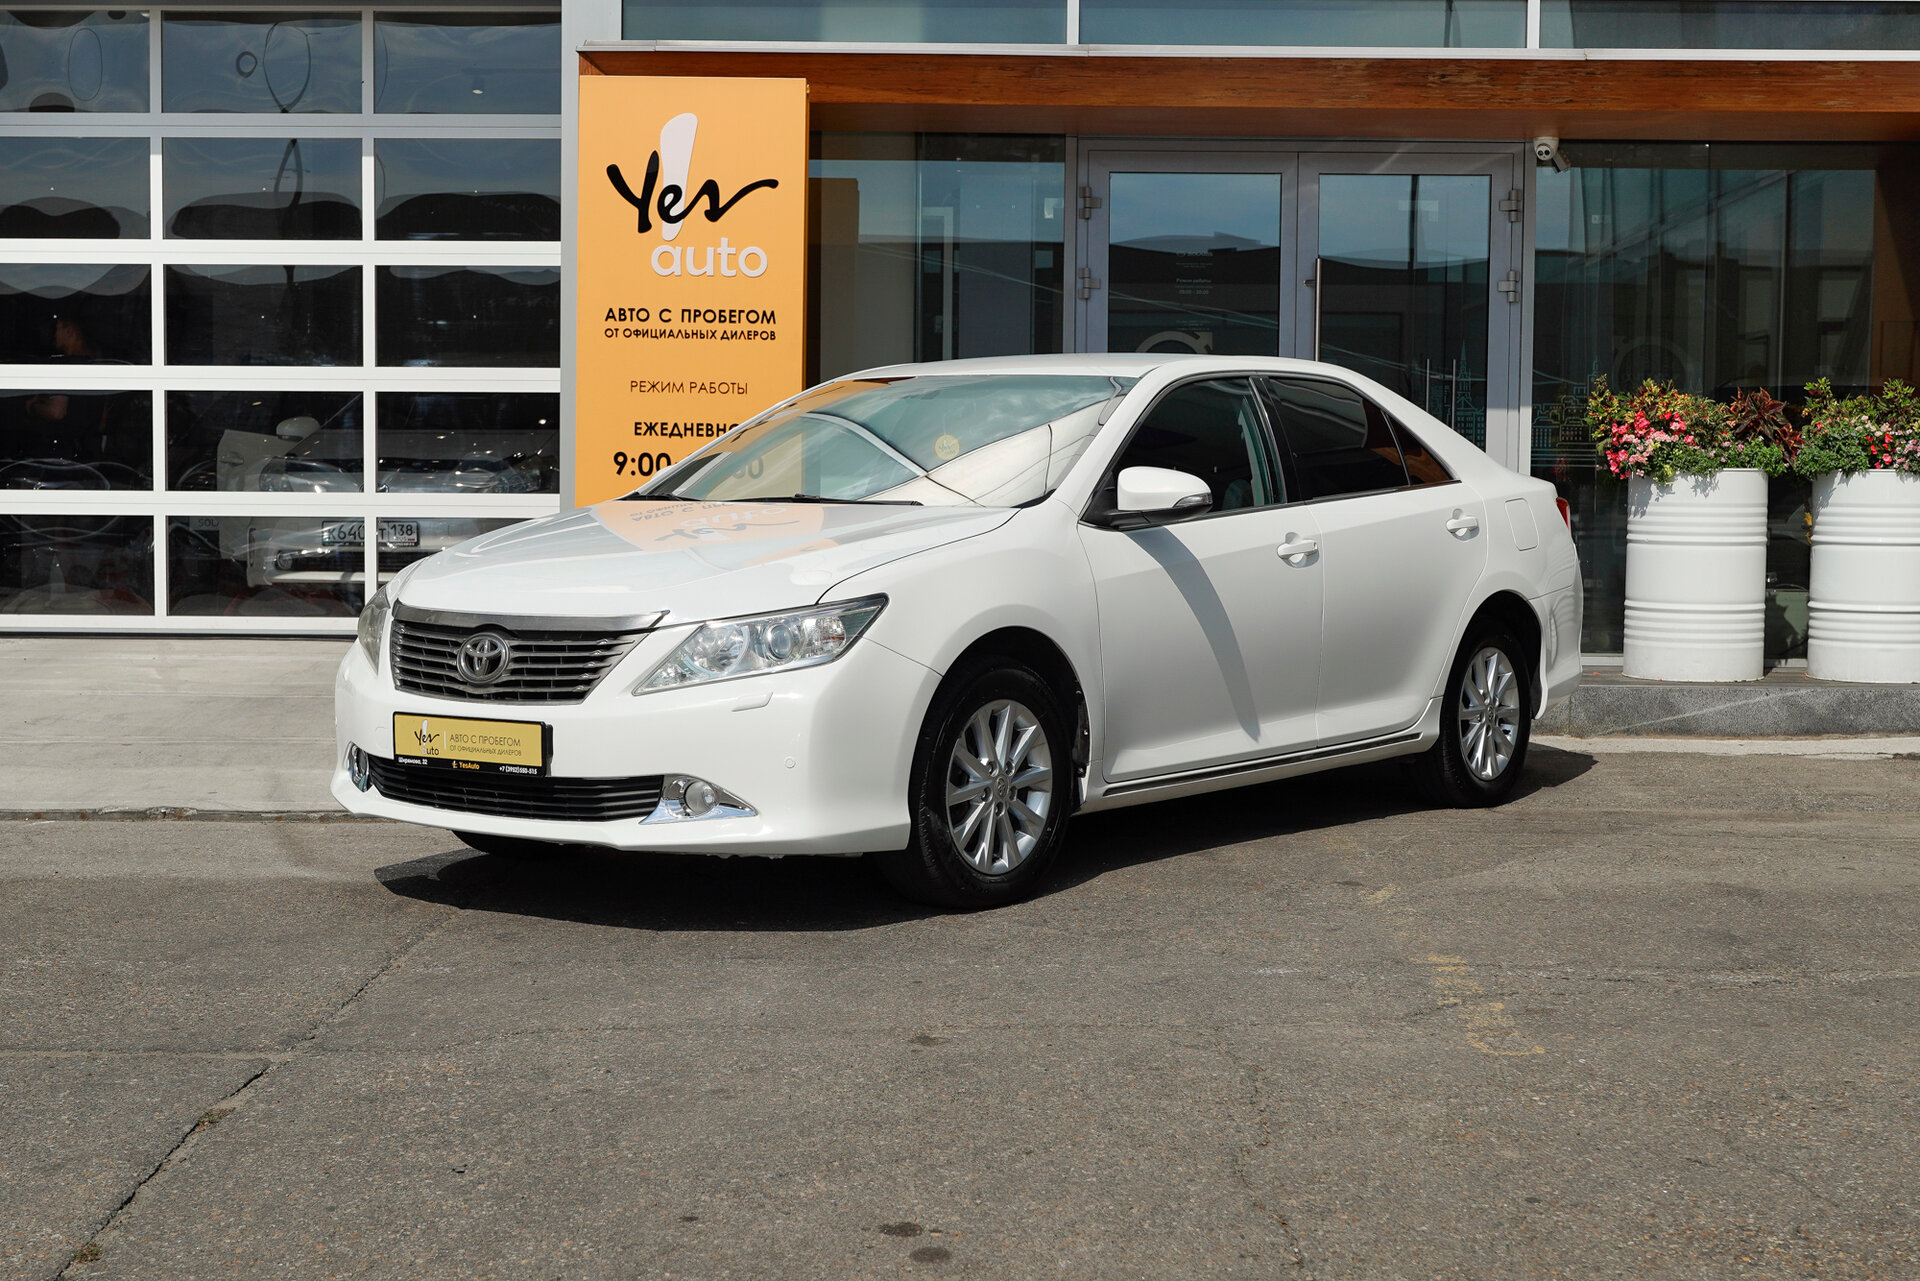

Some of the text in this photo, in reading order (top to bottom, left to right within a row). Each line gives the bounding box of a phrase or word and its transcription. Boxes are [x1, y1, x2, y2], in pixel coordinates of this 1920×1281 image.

[650, 237, 768, 278] auto
[604, 307, 776, 325] АВТО С ПРОБЕГОМ
[604, 328, 776, 341] ОТ ОФИЦИАЛЬНЫХ ДИЛЕРОВ
[630, 380, 748, 395] РЕЖИМ РАБОТЫ
[390, 524, 413, 536] 138
[449, 733, 521, 747] АВТО С ПРОБЕГОМ
[421, 746, 440, 756] auto
